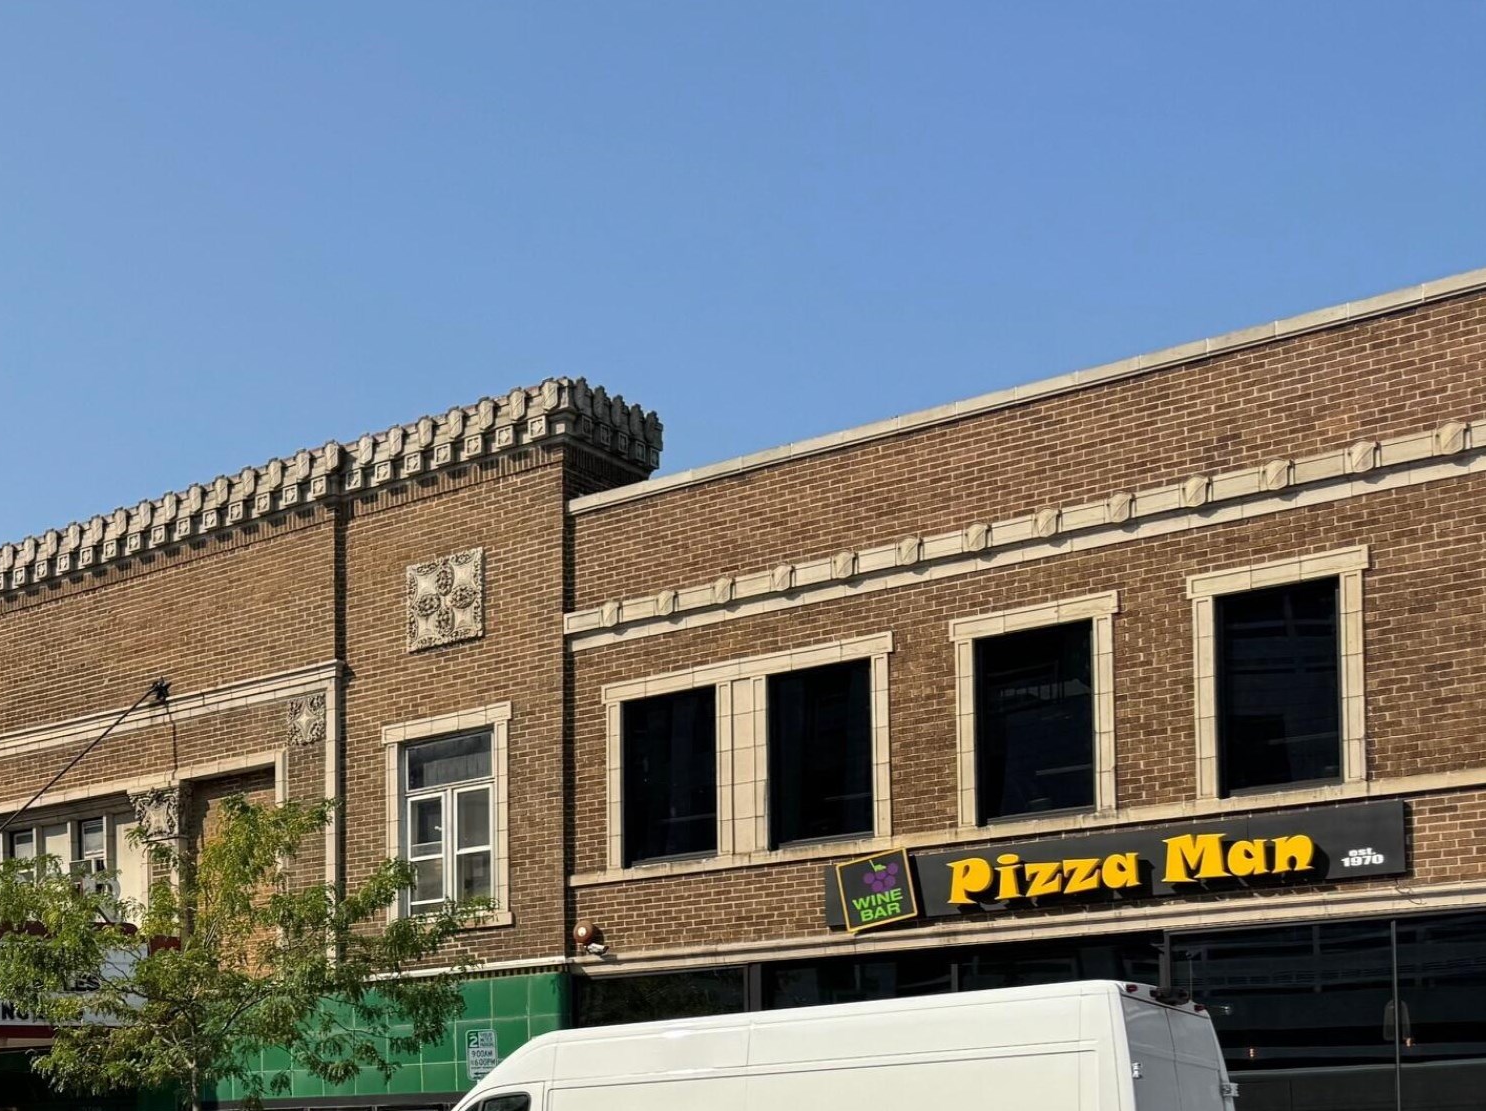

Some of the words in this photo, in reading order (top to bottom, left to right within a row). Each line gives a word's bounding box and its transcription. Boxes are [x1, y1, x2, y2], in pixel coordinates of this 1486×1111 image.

[1340, 854, 1384, 867] 1970
[1348, 847, 1376, 857] est.
[946, 852, 1141, 903] Pizza
[1162, 833, 1314, 883] Man
[852, 887, 903, 910] WINE
[860, 902, 901, 922] BAR
